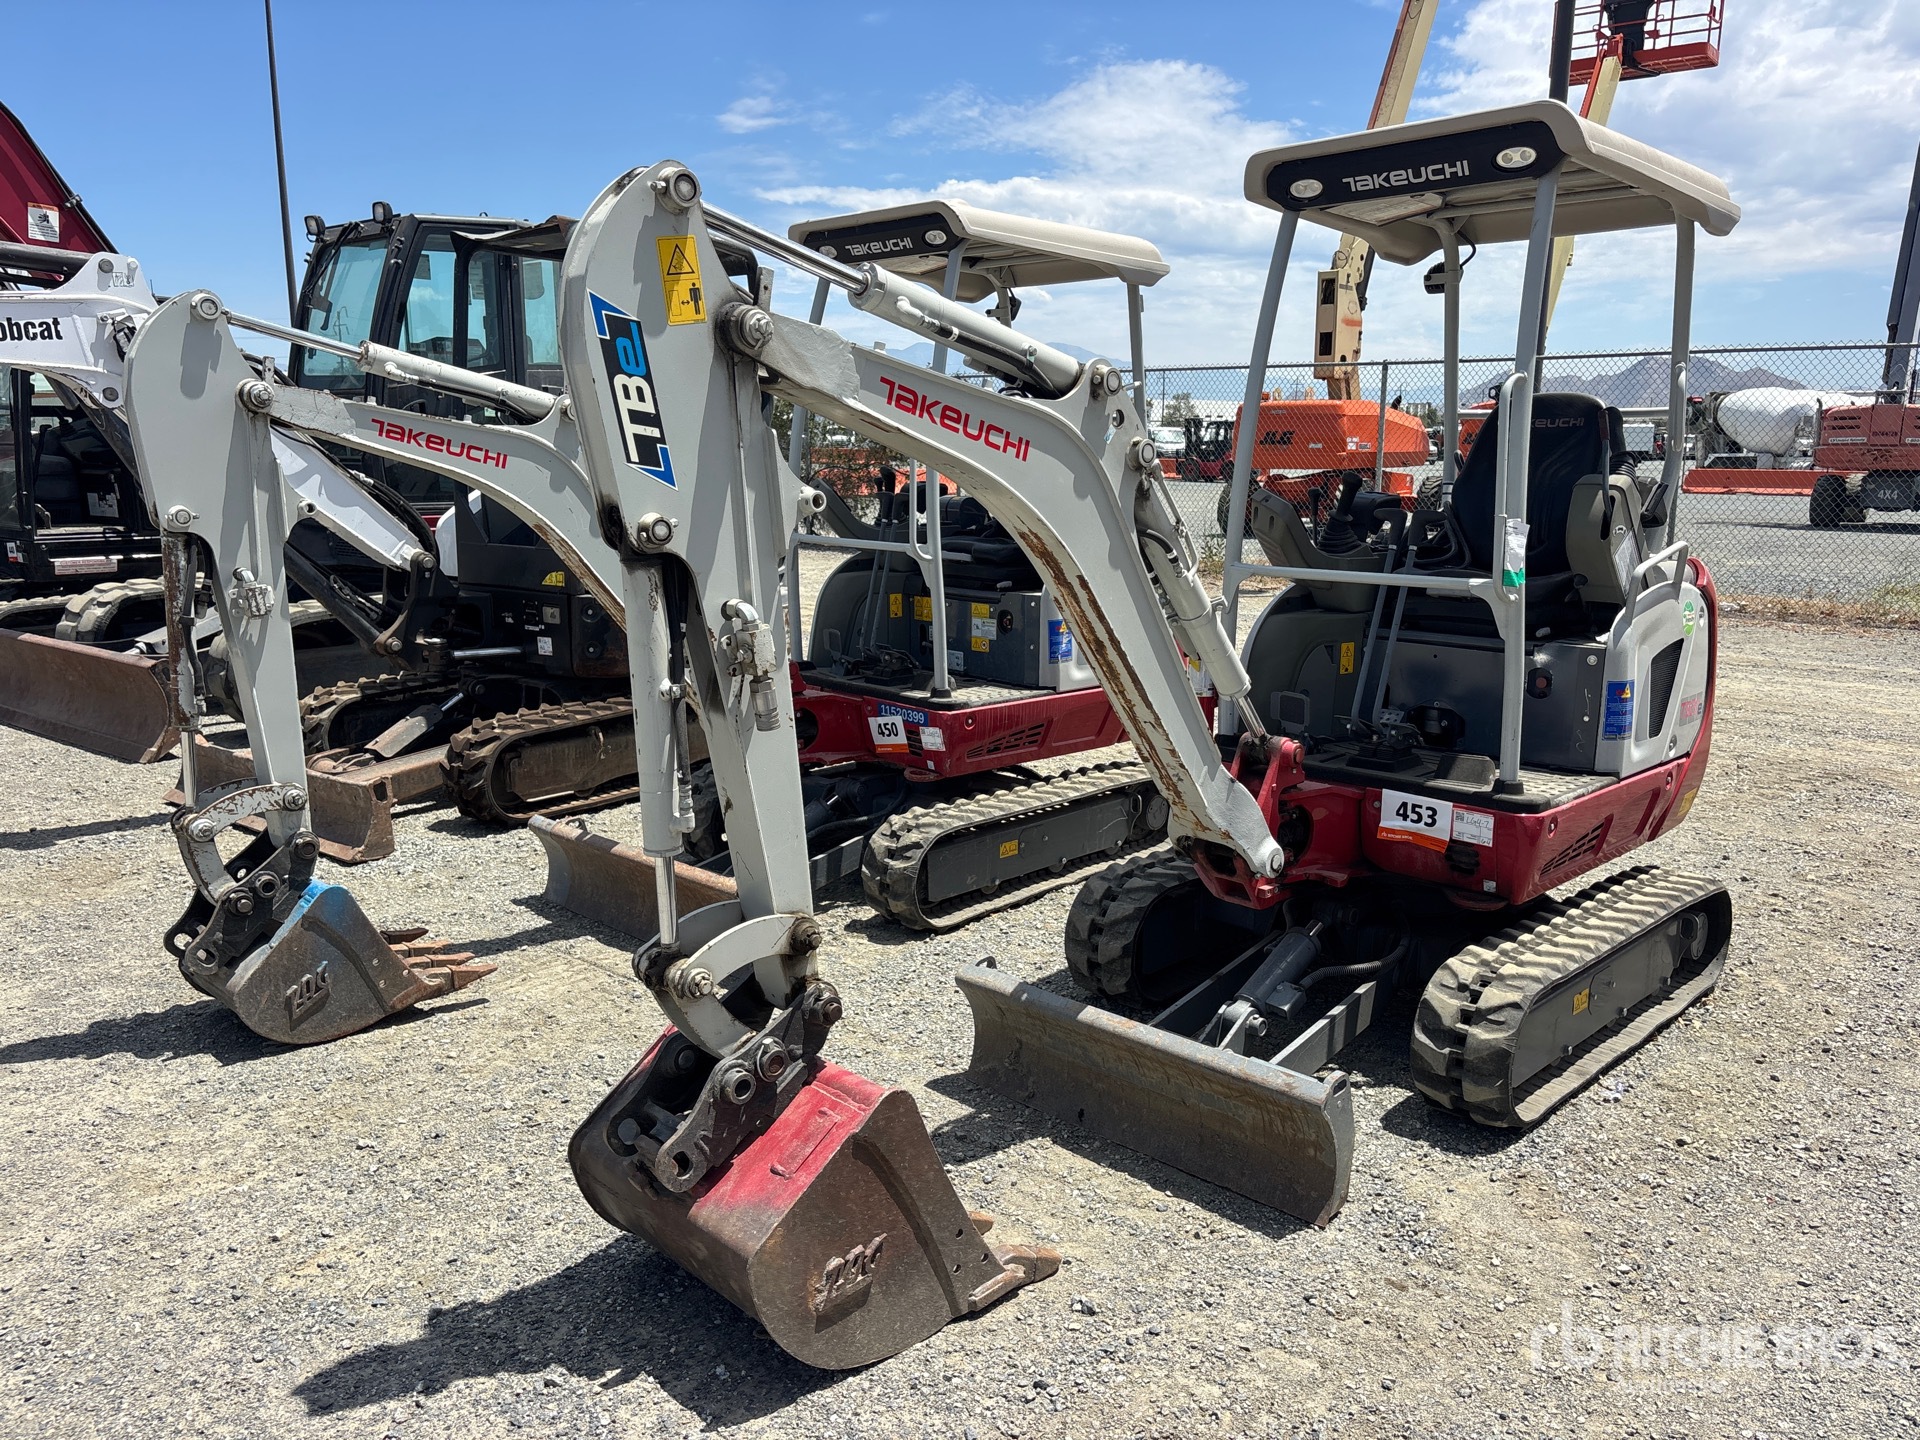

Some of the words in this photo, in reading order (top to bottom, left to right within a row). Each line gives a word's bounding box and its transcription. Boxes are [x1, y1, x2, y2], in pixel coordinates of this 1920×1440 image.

[1342, 160, 1470, 192] TAKEUCHI
[845, 237, 913, 256] TAKEUCHI
[0, 317, 63, 342] obcat
[879, 375, 1031, 462] TAKEUCHI
[371, 418, 508, 469] TAKEUCHI
[1877, 489, 1898, 500] 4X4
[880, 704, 925, 724] 11520399
[877, 721, 899, 738] 450
[1395, 801, 1438, 828] 453
